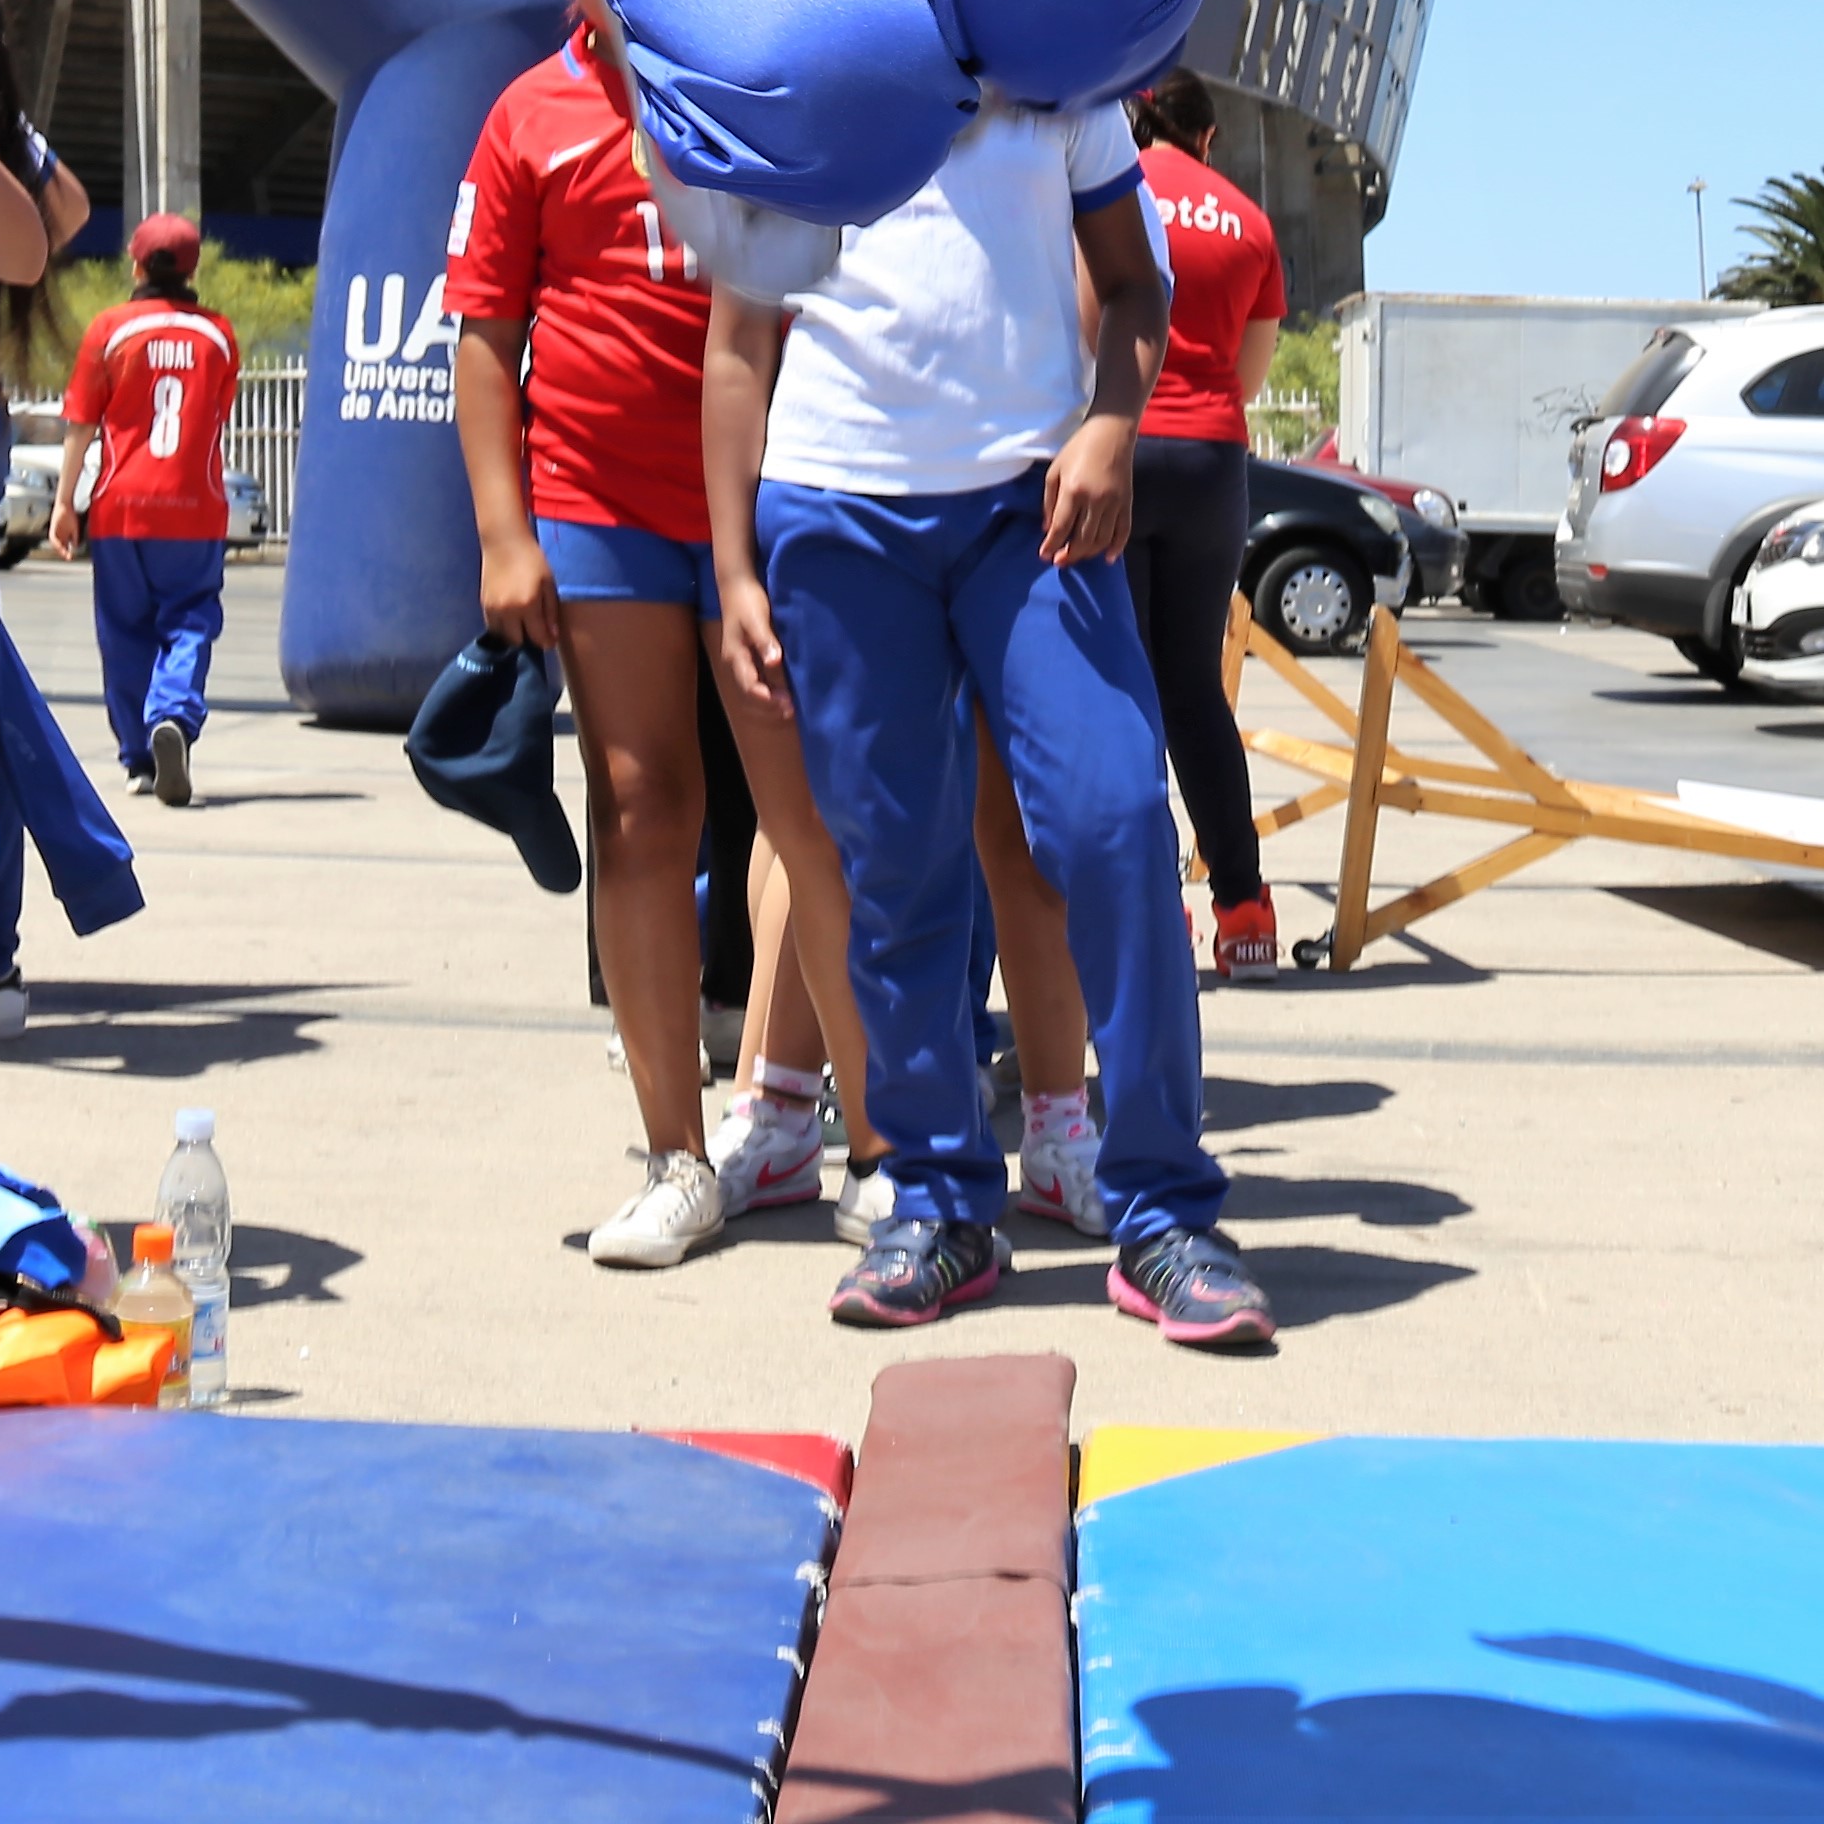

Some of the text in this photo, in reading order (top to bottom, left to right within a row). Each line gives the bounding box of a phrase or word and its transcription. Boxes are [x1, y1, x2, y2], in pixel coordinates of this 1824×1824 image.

[344, 272, 463, 364] UA
[147, 339, 195, 371] VIDAL
[148, 374, 184, 460] 8
[340, 389, 372, 421] de
